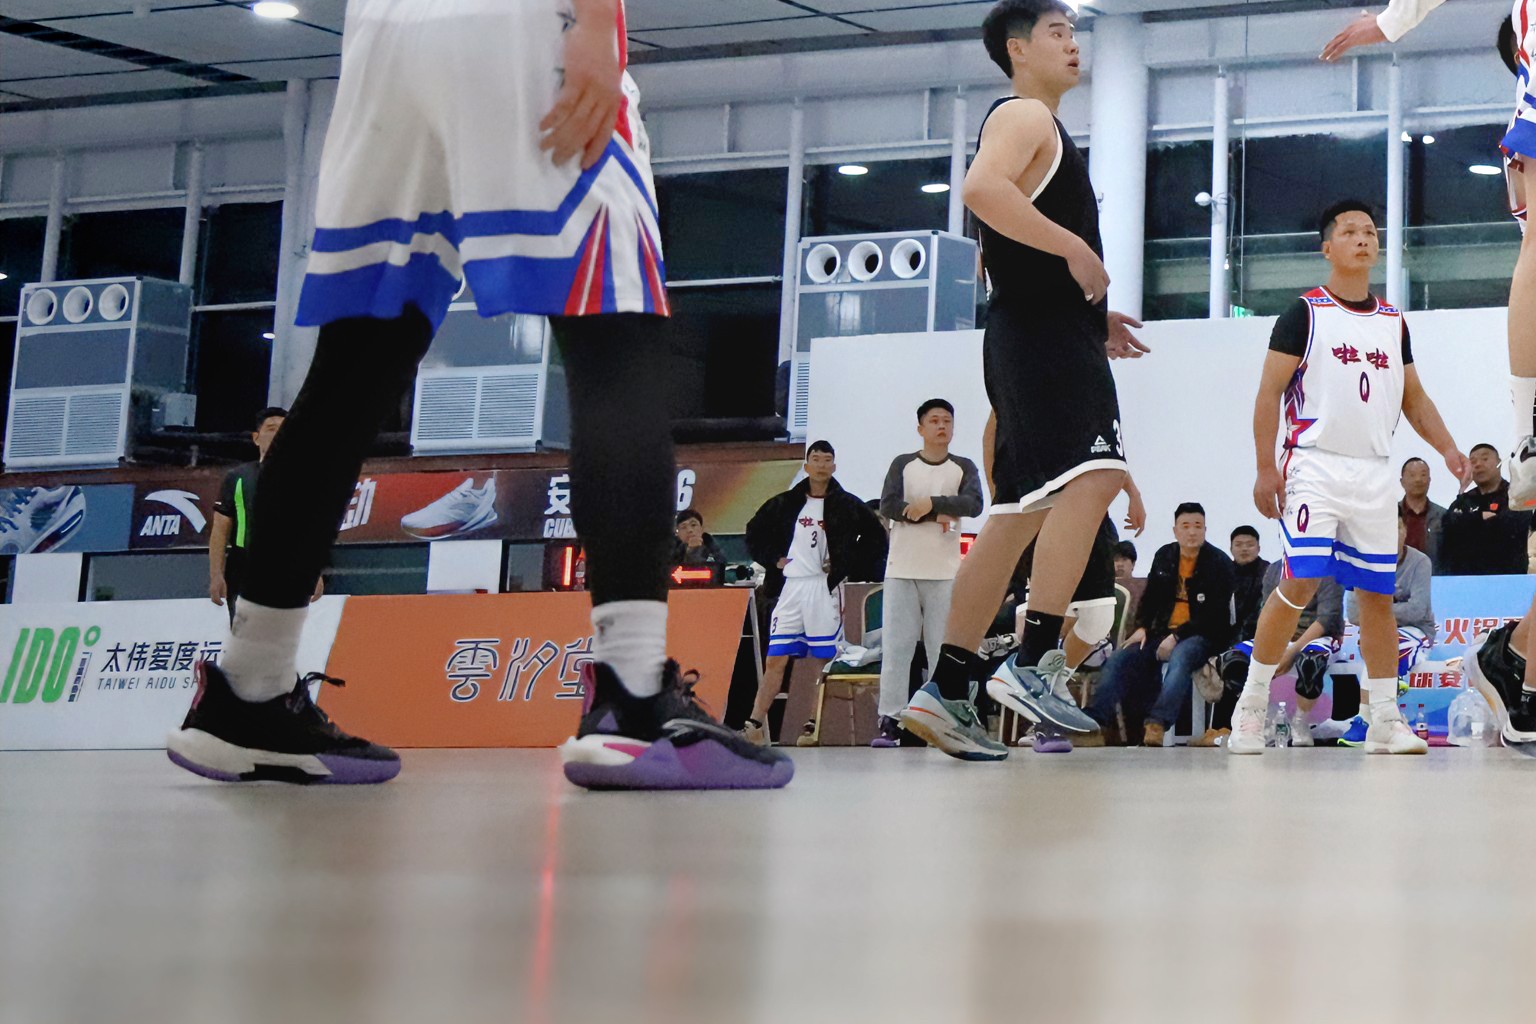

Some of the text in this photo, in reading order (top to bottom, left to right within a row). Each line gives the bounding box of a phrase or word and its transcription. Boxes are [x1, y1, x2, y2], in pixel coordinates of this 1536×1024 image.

[1359, 371, 1370, 404] 0
[140, 514, 181, 536] ANTA
[1297, 503, 1310, 534] 0
[811, 530, 819, 549] 3
[97, 677, 140, 690] TAIWEI
[146, 676, 176, 689] AIDU
